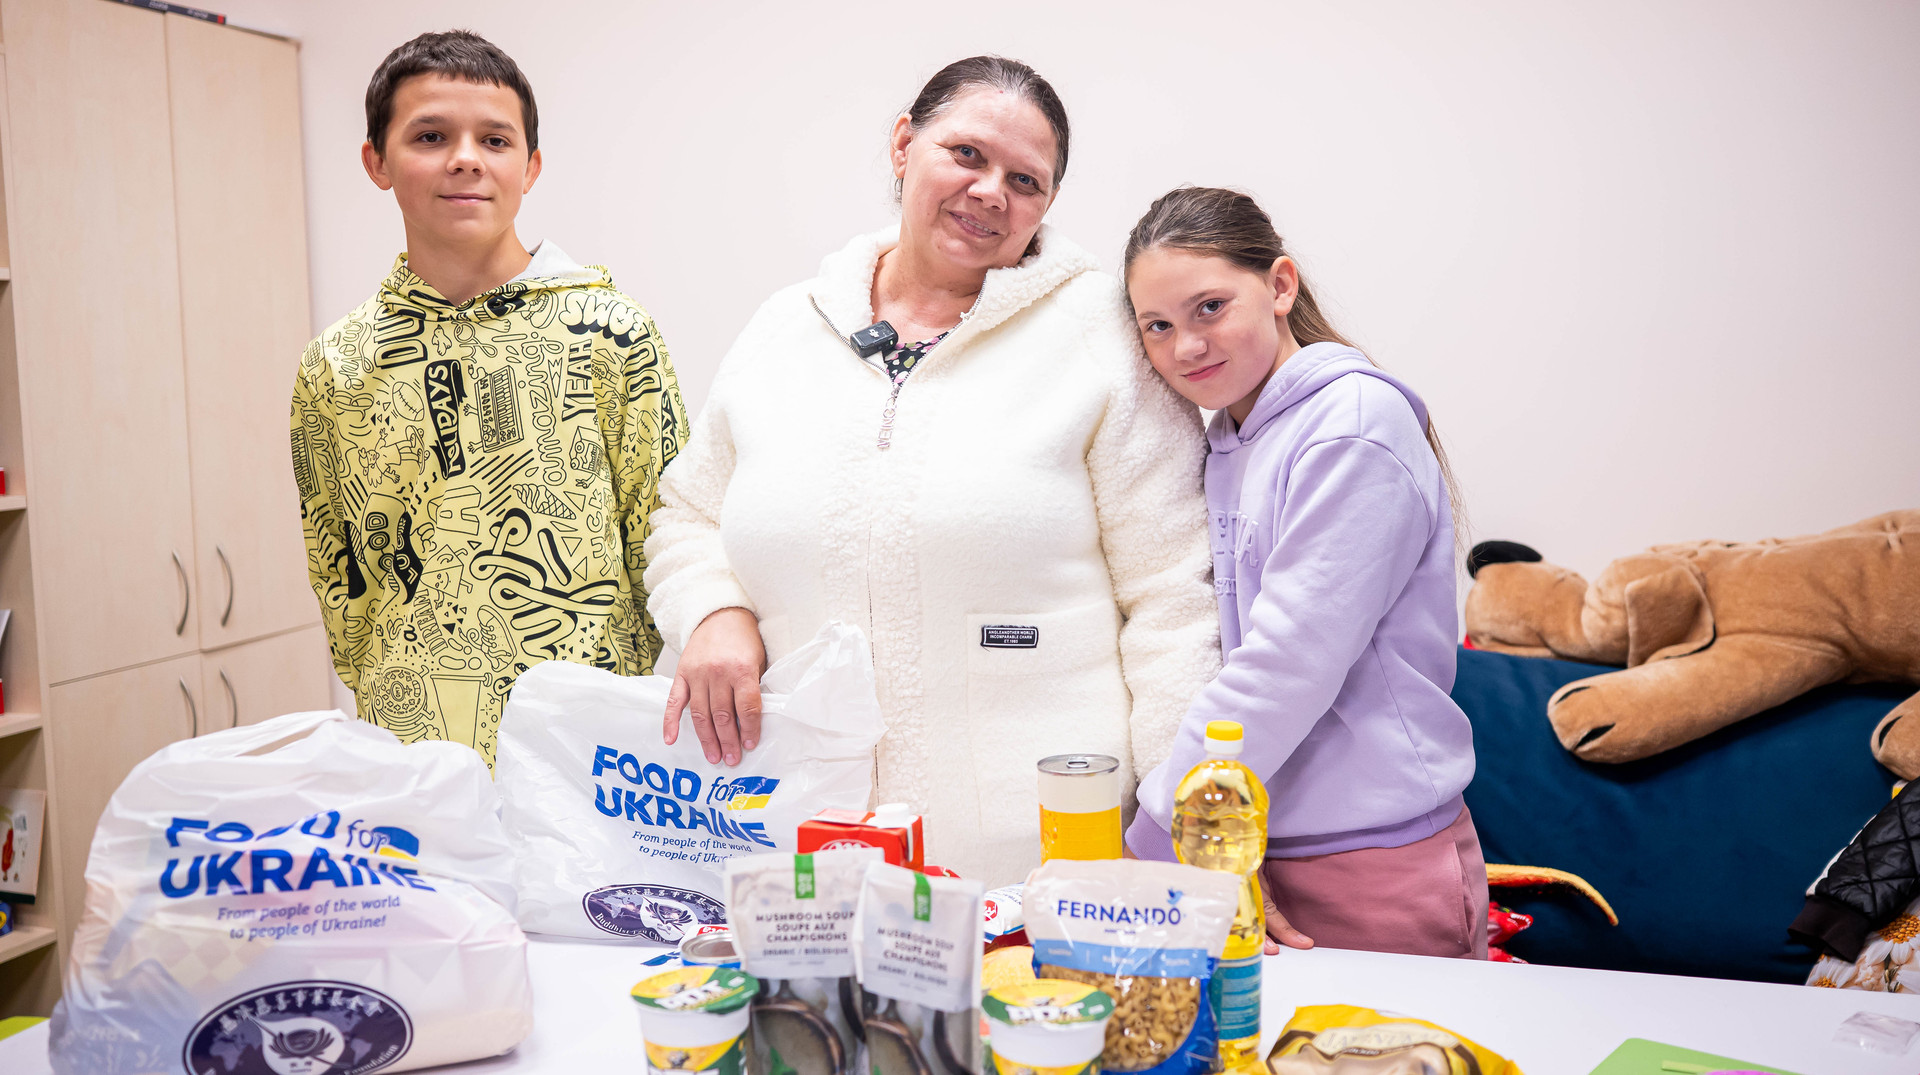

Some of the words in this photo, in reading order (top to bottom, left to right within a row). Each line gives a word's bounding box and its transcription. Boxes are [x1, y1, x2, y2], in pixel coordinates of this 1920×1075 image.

[561, 338, 596, 421] YEAH
[586, 489, 612, 577] LUCK
[412, 588, 449, 657] DREAM
[592, 745, 701, 802] FOOD
[706, 776, 746, 804] for
[594, 783, 777, 848] UKRAINE
[346, 819, 389, 853] for
[632, 831, 660, 844] From
[663, 838, 697, 850] people
[700, 838, 711, 850] of
[712, 839, 727, 850] the
[728, 843, 752, 853] world
[638, 845, 649, 854] to
[651, 849, 687, 862] people
[690, 853, 702, 863] of
[159, 847, 437, 898] UKRAINE
[217, 907, 255, 920] From
[259, 903, 310, 921] people
[314, 900, 330, 916] of
[333, 899, 356, 912] the
[361, 896, 401, 909] world
[756, 912, 822, 921] MUSHROOM
[827, 911, 854, 920] SOUP
[1058, 900, 1181, 925] FERNANDO
[229, 928, 244, 939] to
[248, 923, 299, 942] people
[303, 920, 319, 935] of
[322, 915, 387, 932] Ukraine!
[766, 932, 848, 942] CHAMPIGNONS
[776, 923, 809, 931] SOUPE
[814, 922, 835, 930] AUX
